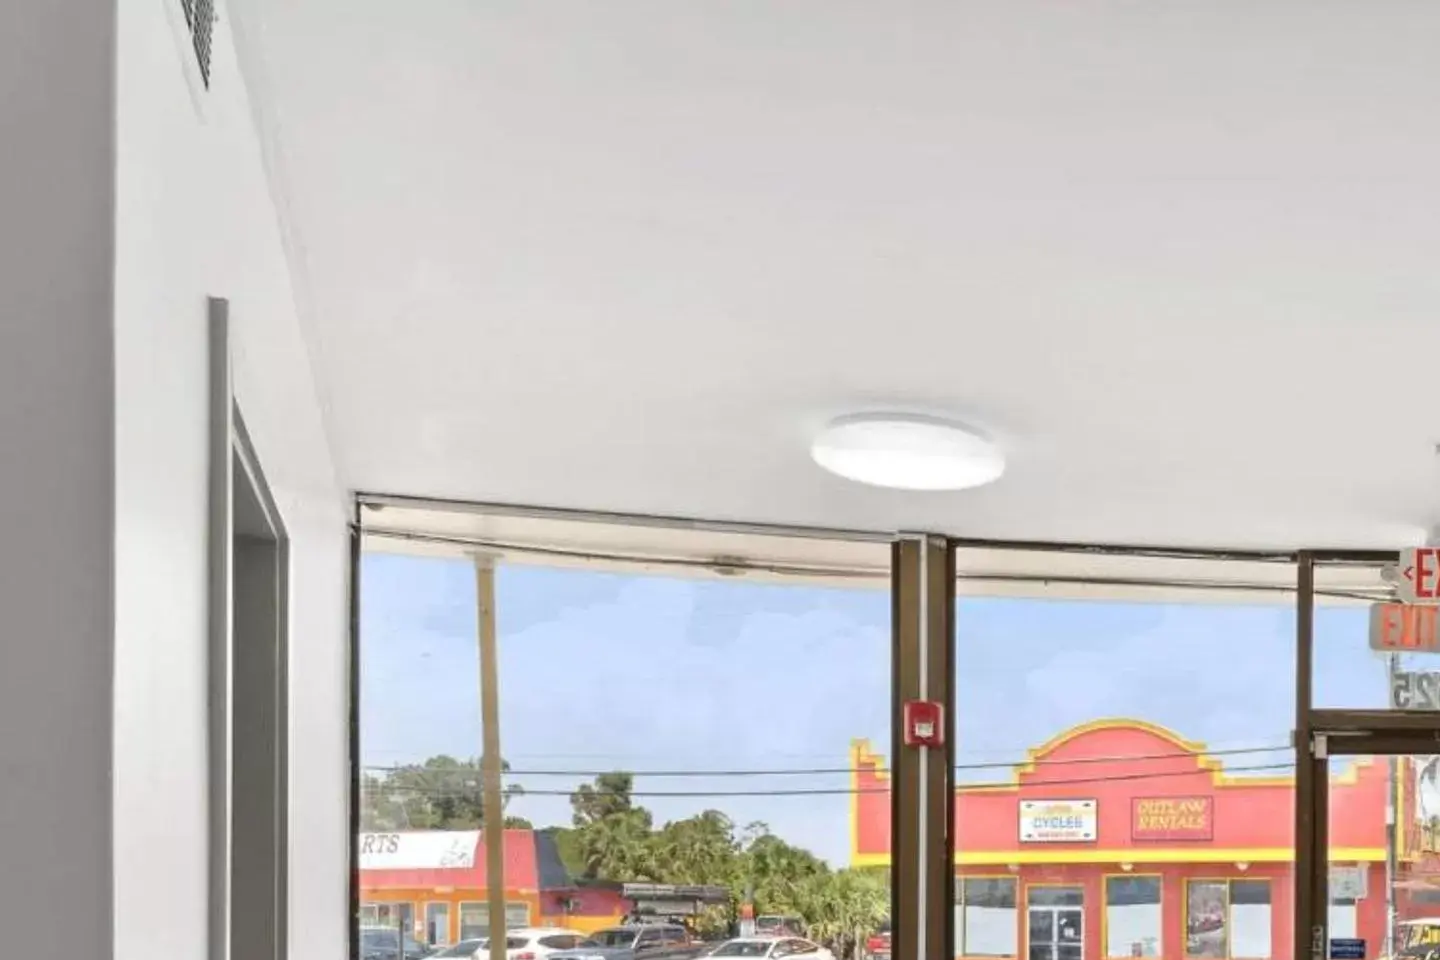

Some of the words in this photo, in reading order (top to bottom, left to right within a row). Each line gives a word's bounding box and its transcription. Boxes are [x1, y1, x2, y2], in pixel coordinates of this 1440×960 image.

[1381, 604, 1440, 648] EXIT
[1138, 800, 1206, 816] OUTLAW
[1138, 815, 1205, 830] RENTALS
